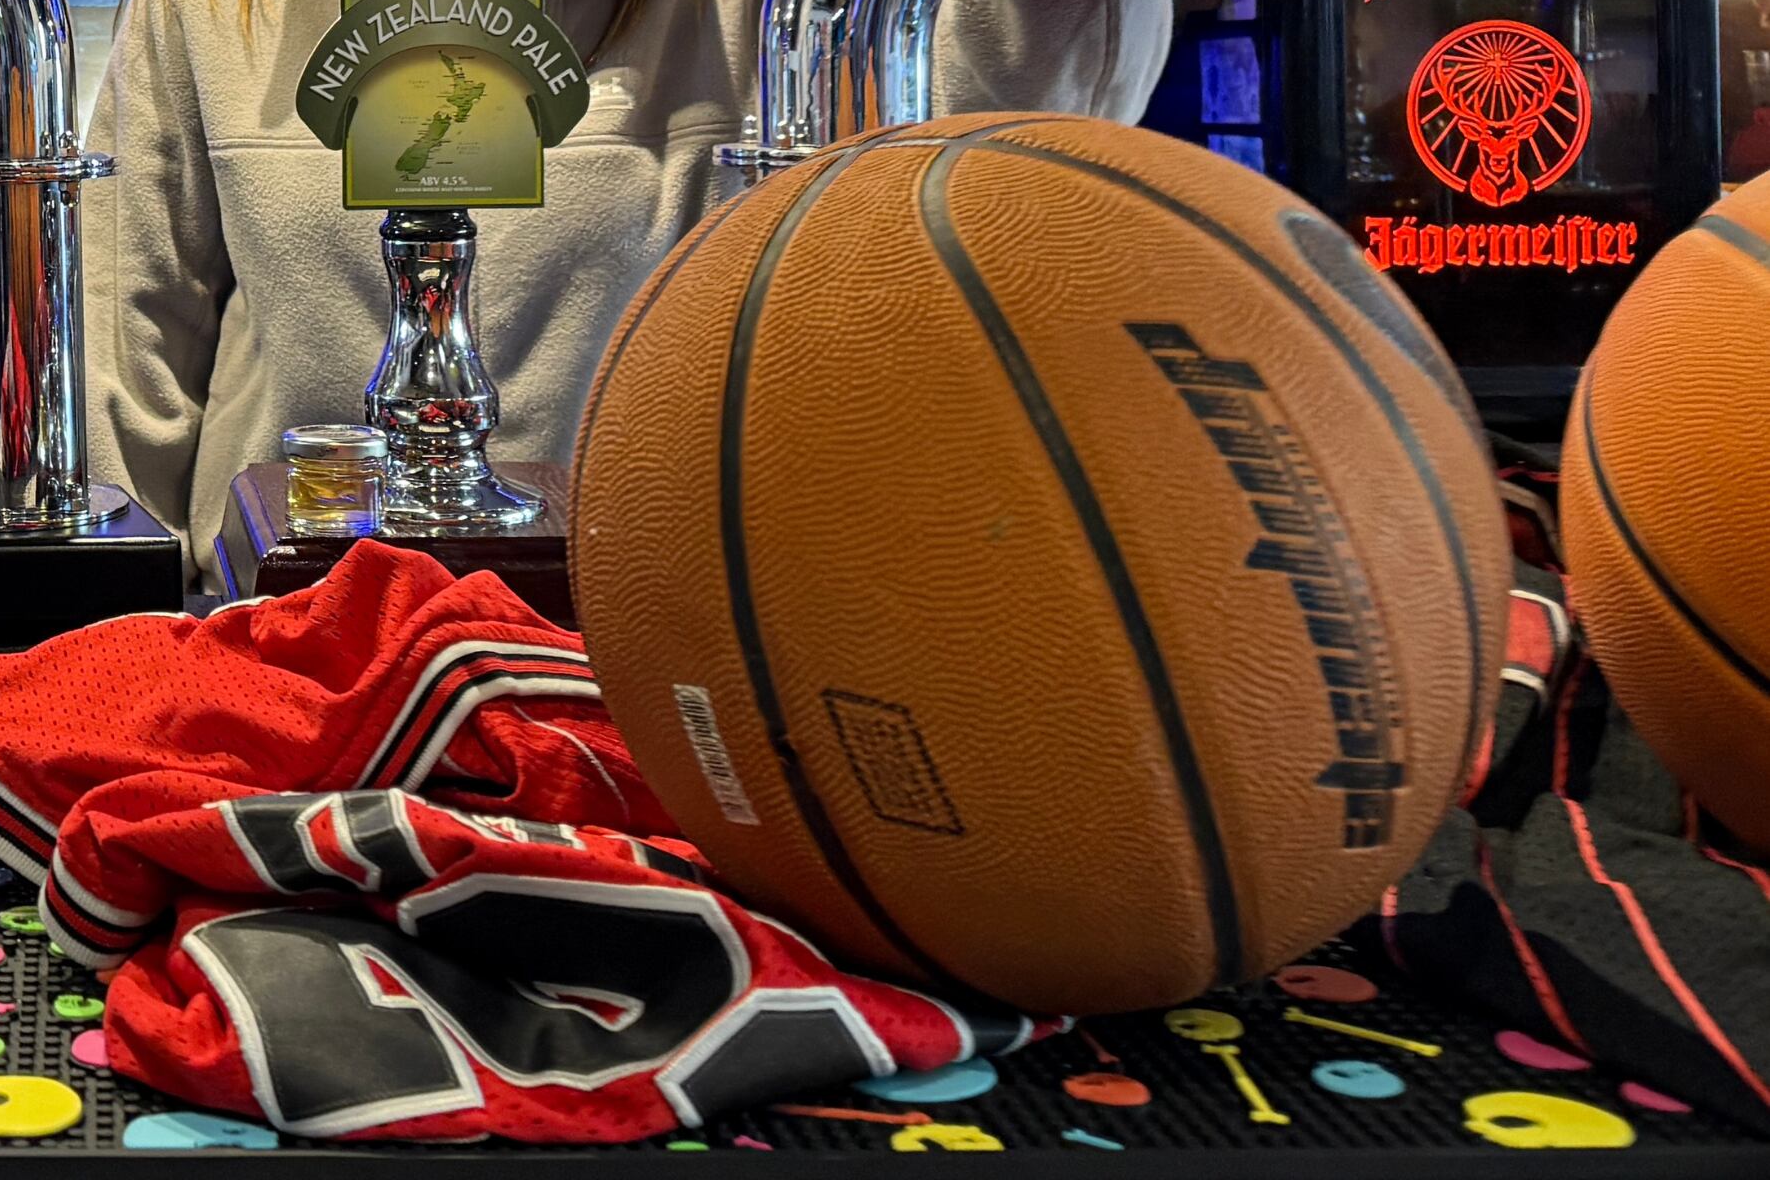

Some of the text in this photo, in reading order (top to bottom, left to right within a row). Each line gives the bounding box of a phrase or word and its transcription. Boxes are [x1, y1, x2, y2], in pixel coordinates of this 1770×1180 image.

[309, 28, 370, 101] NEW
[511, 23, 579, 96] PALE
[419, 176, 441, 186] ABV
